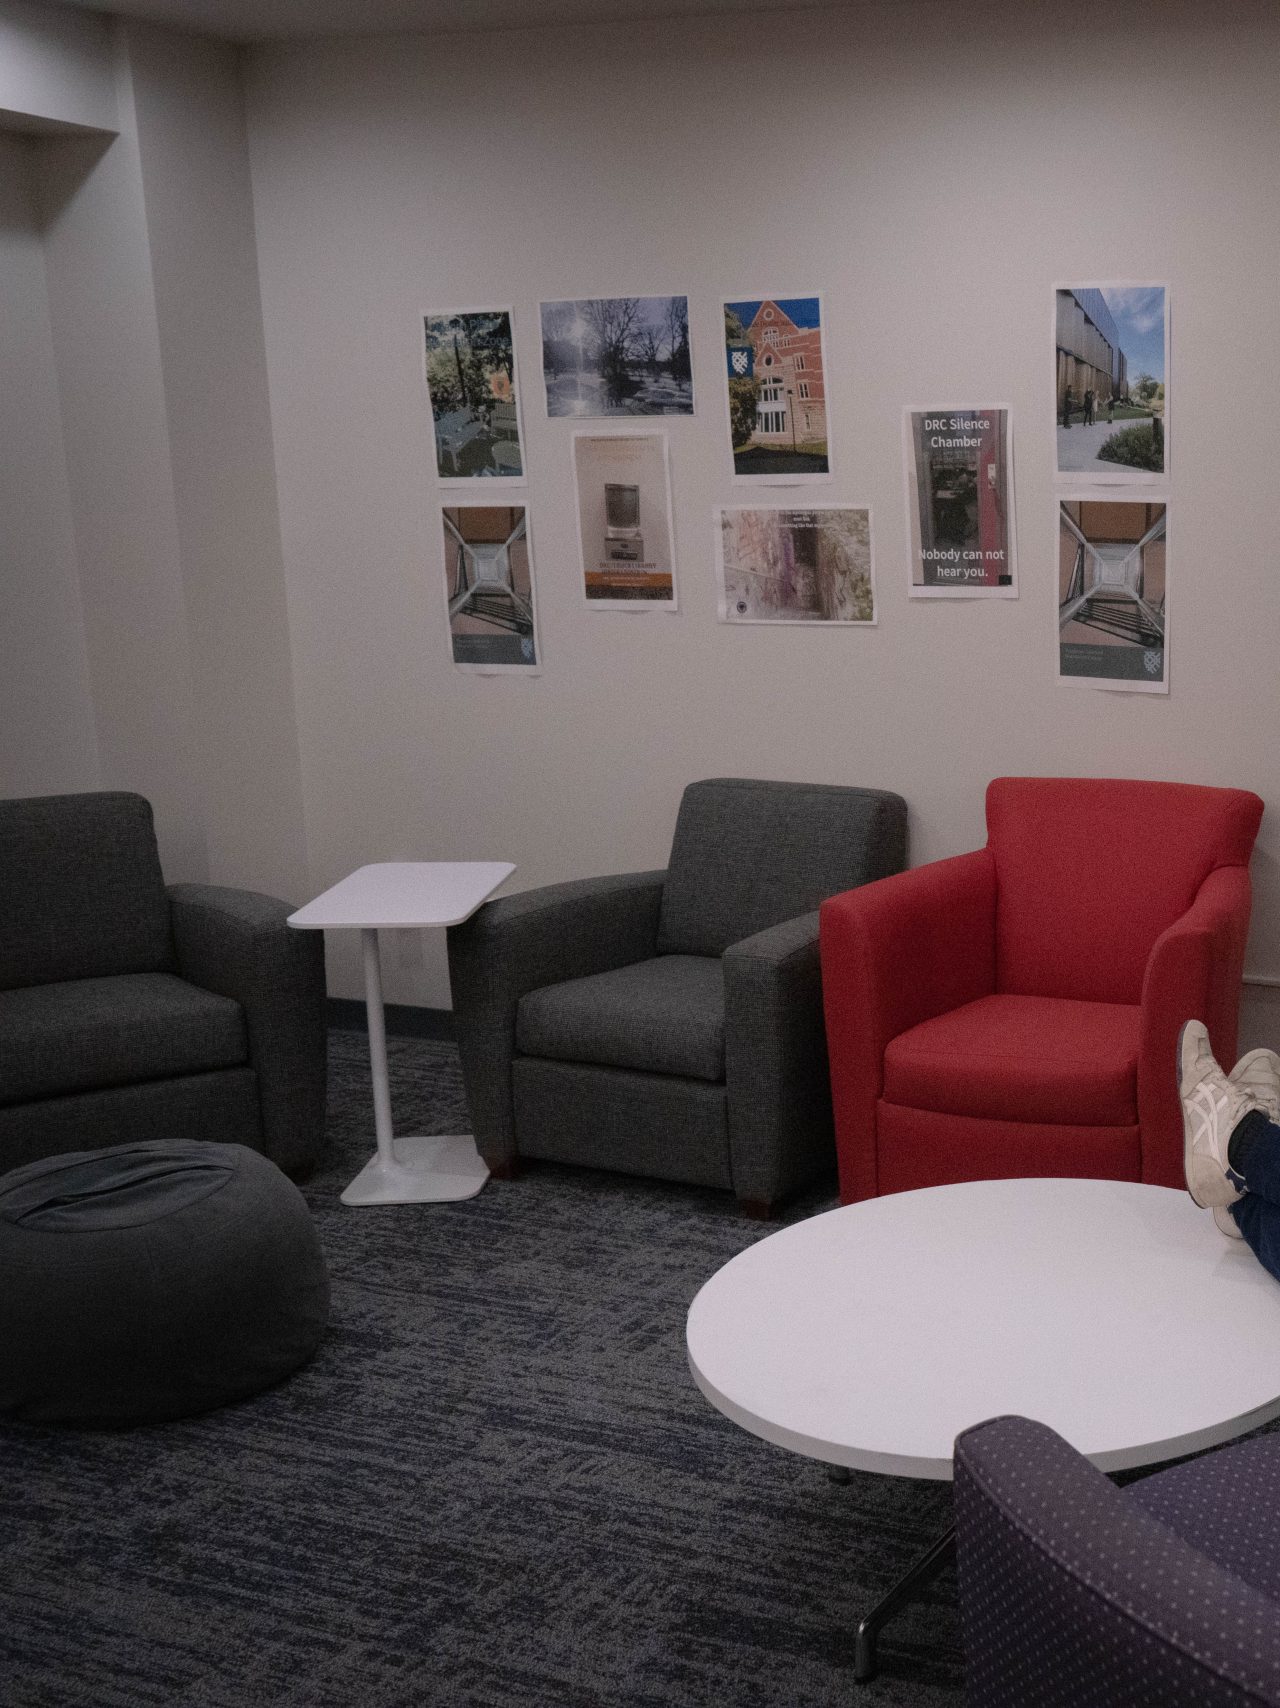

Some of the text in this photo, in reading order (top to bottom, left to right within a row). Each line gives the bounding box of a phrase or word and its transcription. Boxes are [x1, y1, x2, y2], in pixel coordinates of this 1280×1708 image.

[924, 418, 990, 431] DRC Silence
[931, 436, 983, 449] Chamber
[919, 548, 1005, 562] Nobody can not
[937, 566, 989, 579] hear you.
